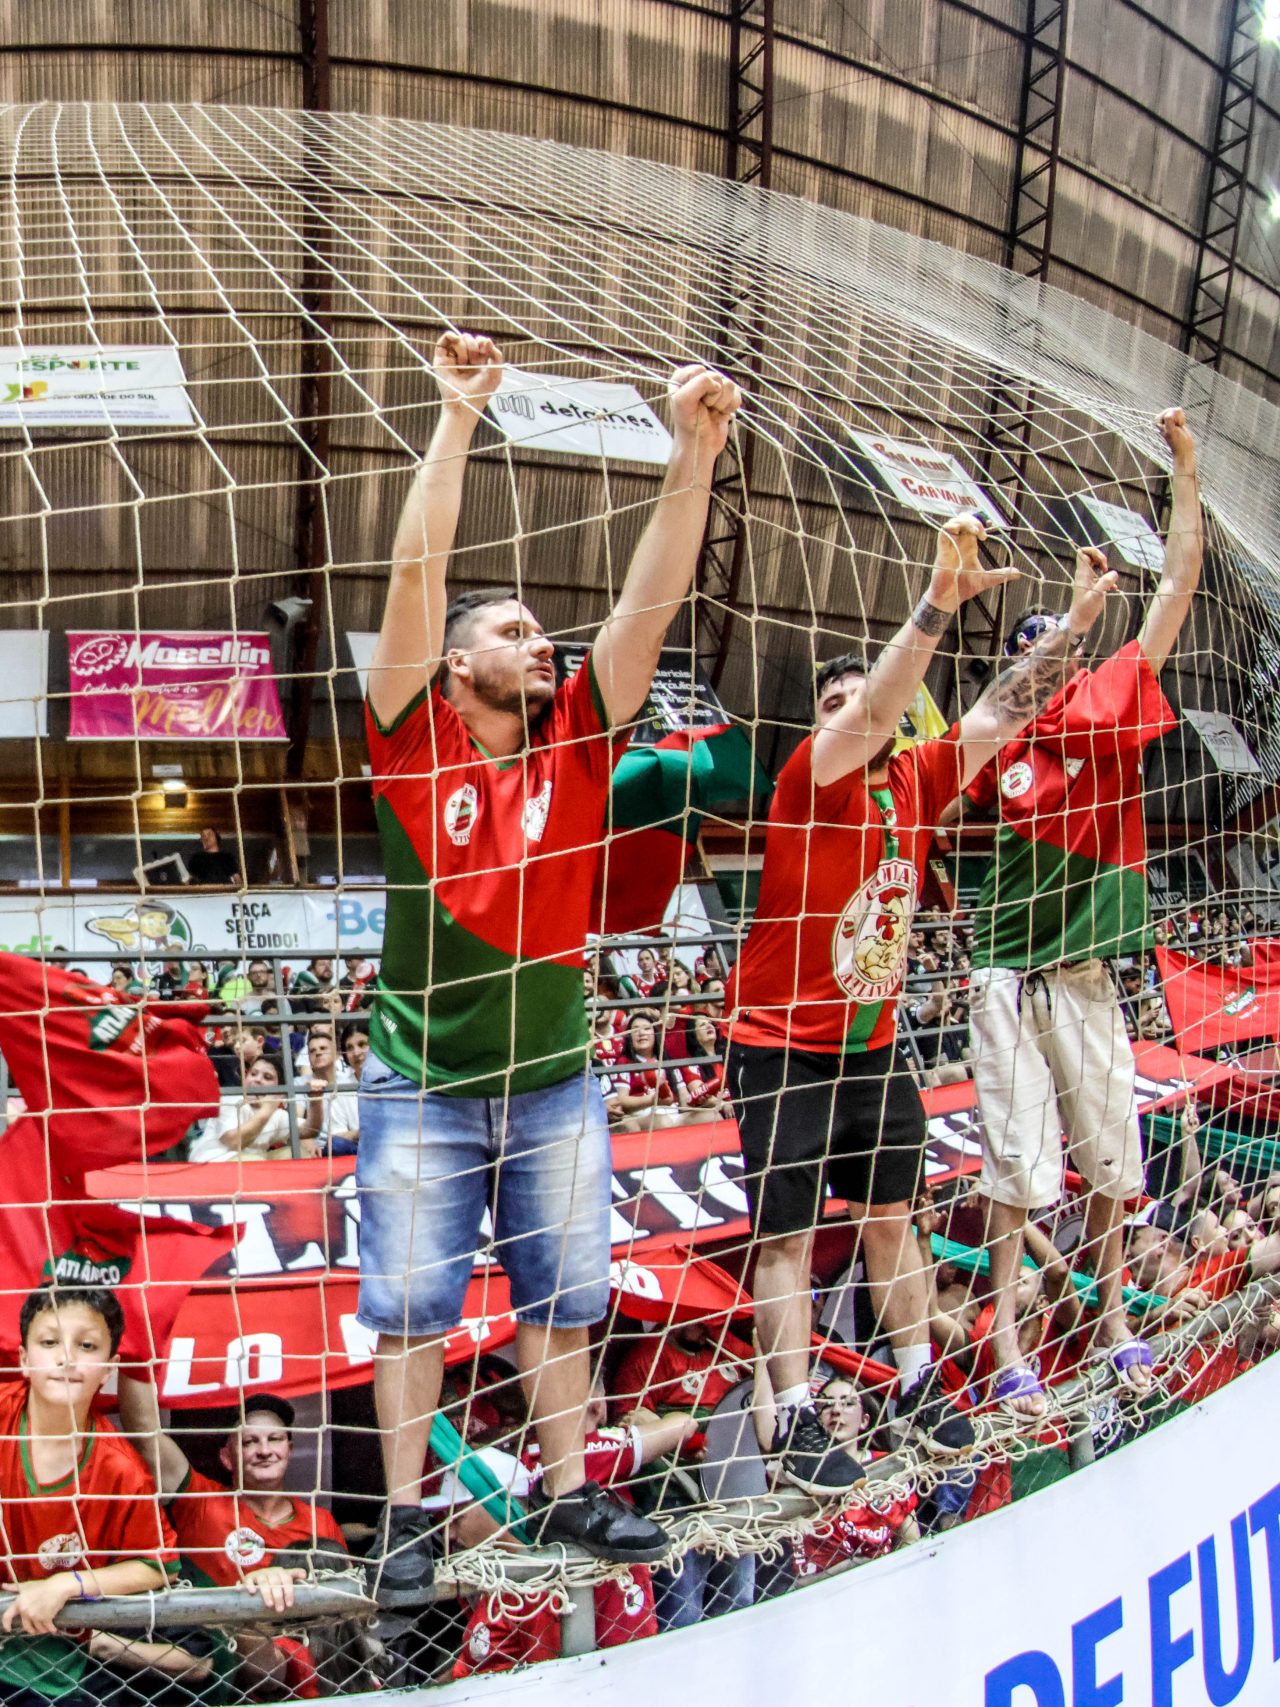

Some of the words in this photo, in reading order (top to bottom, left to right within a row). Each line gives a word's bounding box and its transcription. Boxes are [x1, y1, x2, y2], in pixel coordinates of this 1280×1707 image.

[123, 640, 271, 670] Mocellin
[231, 902, 271, 919] FAÇA
[225, 919, 256, 933] SEU
[236, 932, 300, 949] PEDIDO!
